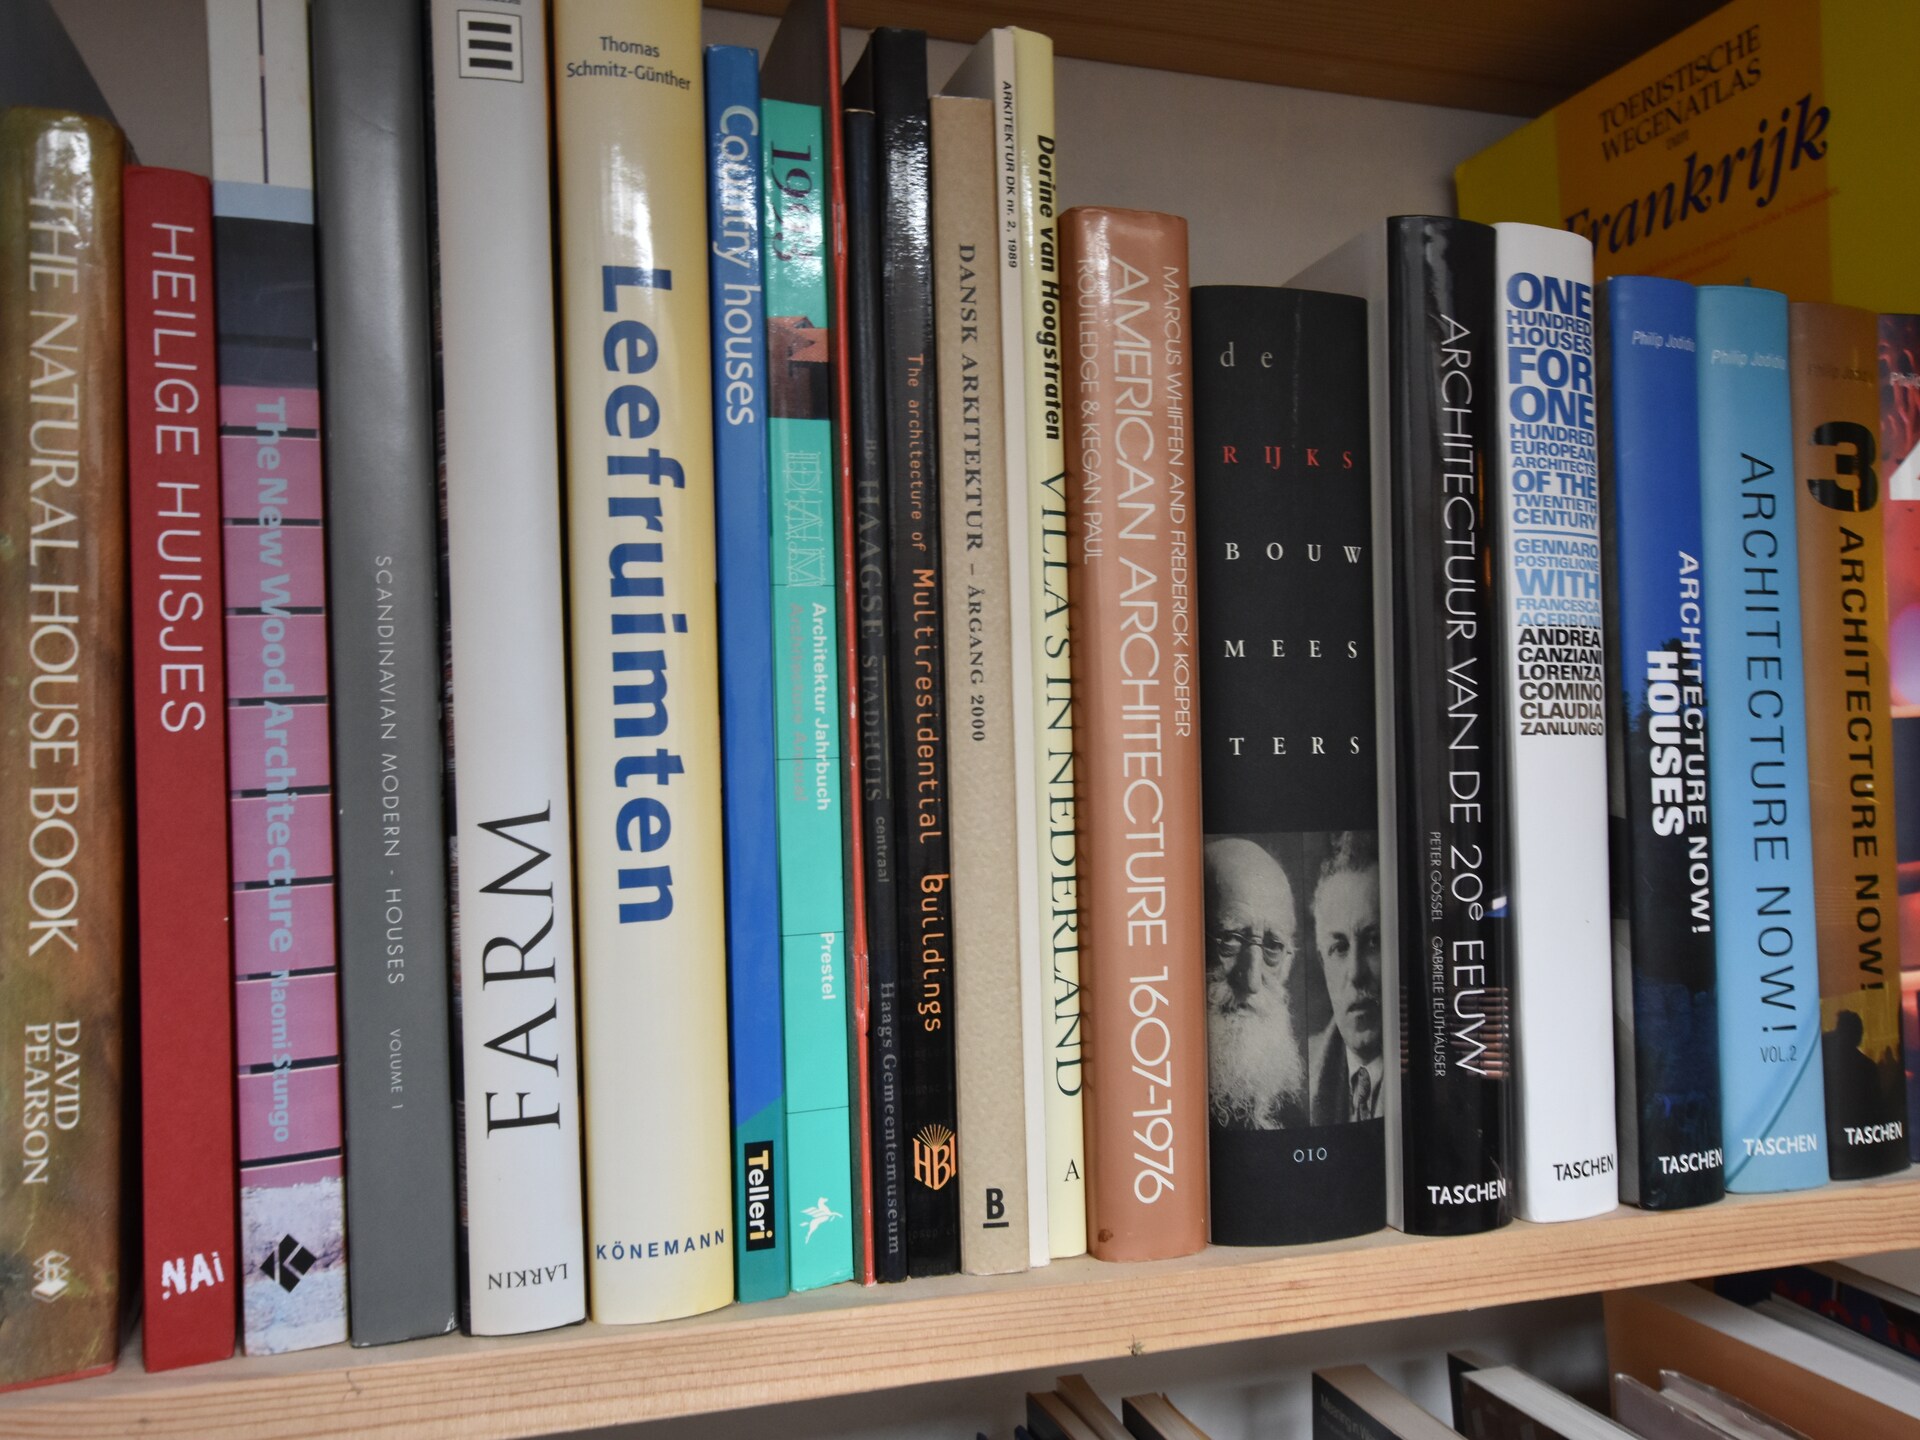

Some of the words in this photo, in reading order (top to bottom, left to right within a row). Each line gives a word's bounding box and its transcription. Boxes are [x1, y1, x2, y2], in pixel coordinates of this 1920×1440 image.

[566, 60, 692, 91] Schmitz-Günther
[600, 36, 661, 58] Thomas
[1600, 24, 1761, 134] TOERISTISCHE
[1003, 80, 1015, 173] ARKITEKTUR
[1601, 58, 1762, 162] WEGENATLAS
[713, 105, 760, 269] Country
[1005, 175, 1016, 196] DK
[1006, 198, 1016, 216] nr.
[1037, 134, 1056, 218] Dorine
[29, 197, 79, 294] THE
[1007, 238, 1018, 268] 1989
[1039, 226, 1055, 272] van
[959, 243, 978, 344] DANSK
[1077, 259, 1100, 393] ROUTLEDGE
[1162, 266, 1182, 366] MARCUS
[1505, 271, 1592, 322] ONE
[1506, 309, 1592, 338] HUNDRED
[151, 222, 200, 456] HEILIGE
[724, 283, 761, 426] houses
[907, 352, 924, 388] The
[1036, 280, 1061, 440] Hoogstraten
[1507, 327, 1593, 357] HOUSES
[1508, 346, 1593, 395] FOR
[256, 396, 288, 470] The
[1080, 400, 1100, 418] &
[1111, 256, 1157, 540] AMERICAN
[1166, 372, 1184, 466] WHIFFEN
[1509, 385, 1595, 431] ONE
[1510, 423, 1595, 448] HUNDRED
[29, 310, 79, 567] NATURAL
[908, 400, 925, 520] architecture
[961, 354, 983, 551] ARKITEKTUR
[1081, 424, 1103, 504] KEGAN
[1440, 313, 1478, 640] ARCHITECTUUR
[1510, 440, 1596, 463] EUROPEAN
[1512, 456, 1597, 478] ARCHITECTS
[1807, 421, 1879, 513] 3
[257, 477, 289, 567] New
[1169, 471, 1187, 524] AND
[1512, 470, 1551, 493] OF
[1556, 471, 1598, 501] THE
[1512, 493, 1598, 515] TWENTIETH
[1512, 508, 1598, 531] CENTURY
[857, 479, 885, 640] HAAGSE
[911, 532, 927, 552] of
[1083, 512, 1104, 566] PAUL
[1225, 541, 1361, 565] BOUW
[1514, 538, 1598, 560] GENNARO
[1514, 555, 1599, 573] POSTIGLIONE
[156, 481, 206, 732] HUISJES
[602, 265, 688, 925] Leefruimten
[1170, 531, 1190, 647] FREDERICK
[1515, 568, 1600, 600] WITH
[1516, 598, 1600, 615] FRANCESCA
[260, 573, 295, 693] Wood
[375, 555, 397, 741] SCANDINAVIAN
[812, 602, 829, 714] Architektur
[967, 585, 985, 685] ÅRGANG
[1224, 639, 1358, 659] MEES
[1518, 628, 1601, 649] ANDREA
[1518, 664, 1603, 682] LORENZA
[1740, 452, 1791, 862] ARCHITECTURE
[28, 583, 79, 769] HOUSE
[913, 569, 942, 844] Multiresidential
[1046, 672, 1073, 730] IN
[1173, 653, 1191, 737] KOEPER
[1446, 657, 1480, 750] VAN
[1519, 682, 1603, 702] COMINO
[1520, 702, 1604, 720] CLAUDIA
[1678, 550, 1708, 825] ARCHITECTURE
[1838, 526, 1879, 859] ARCHITECTURE
[861, 655, 883, 800] STADHUIS
[970, 694, 985, 742] 2000
[1118, 556, 1168, 947] ARCHITECTURE
[1229, 736, 1360, 757] TERS
[1520, 721, 1605, 737] ZANLUNGO
[1646, 650, 1685, 838] HOUSES
[815, 717, 833, 811] Jahrbuch
[1448, 770, 1482, 824] DE
[263, 700, 298, 953] Architecture
[381, 752, 400, 857] MODERN
[28, 786, 79, 957] BOOK
[875, 816, 890, 883] centraal
[1430, 831, 1443, 867] PETER
[1688, 836, 1712, 935] NOW!
[1048, 748, 1084, 1098] NEDERLAND
[1430, 870, 1444, 922] GÖSSEL
[1855, 874, 1885, 991] NOW!
[385, 888, 405, 985] HOUSES
[477, 799, 561, 1140] FARM
[820, 931, 837, 1000] Prestel
[1431, 935, 1445, 993] GABRIELE
[1755, 885, 1799, 1034] NOW!
[270, 968, 293, 1049] Naomi
[877, 982, 896, 1048] Haags
[1432, 997, 1447, 1077] LEUTHÄUSER
[1452, 940, 1488, 1076] EEUW
[55, 1020, 81, 1131] DAVID
[389, 1028, 404, 1094] VOLUME
[1129, 966, 1176, 1205] 1607-1976
[1760, 1043, 1798, 1064] VOL.2
[23, 1022, 50, 1185] PEARSON
[268, 1049, 293, 1143] Stungo
[1844, 1120, 1904, 1147] TASCHEN
[882, 1054, 900, 1254] Gemeentemuseum
[1064, 1158, 1081, 1183] A
[1552, 1153, 1615, 1182] TASCHEN
[1658, 1147, 1724, 1175] TASCHEN
[1743, 1133, 1819, 1157] TASCHEN
[748, 1149, 774, 1240] Telleri
[986, 1188, 1005, 1219] B
[1427, 1177, 1507, 1206] TASCHEN
[488, 1262, 568, 1292] LARKIN
[596, 1229, 725, 1260] KÖNEMANN
